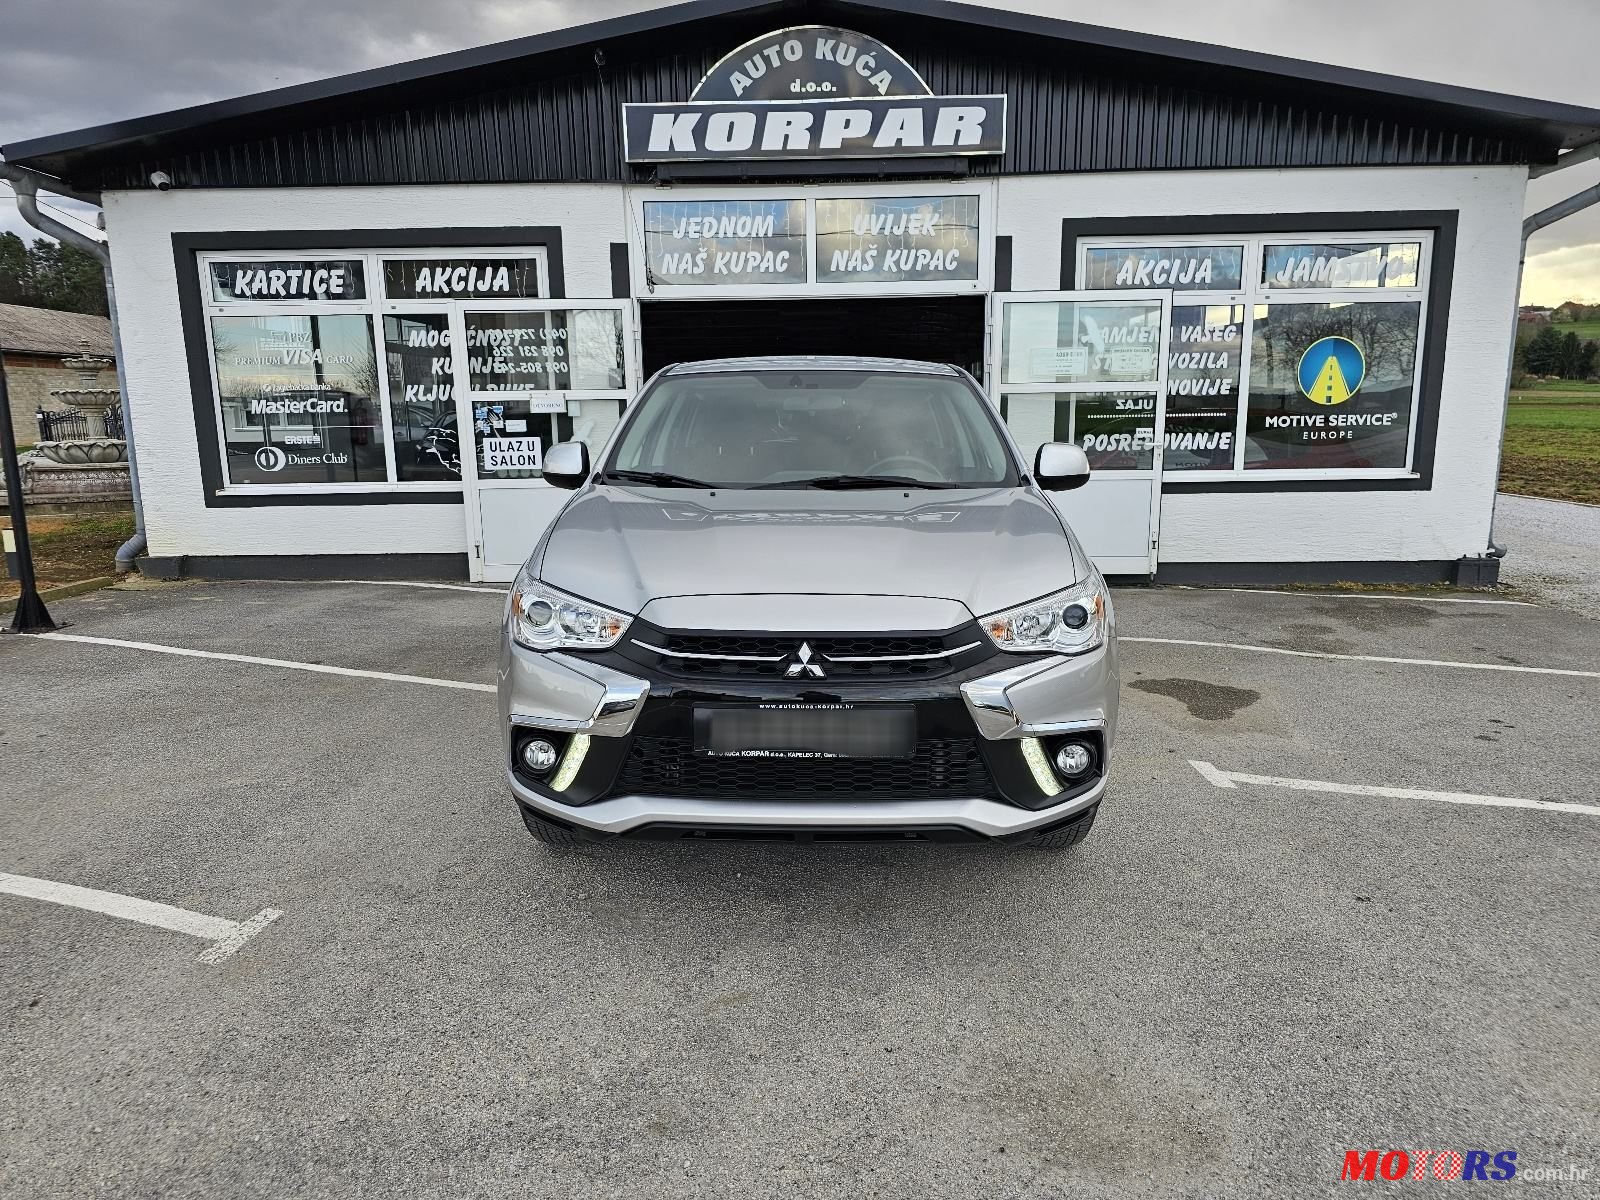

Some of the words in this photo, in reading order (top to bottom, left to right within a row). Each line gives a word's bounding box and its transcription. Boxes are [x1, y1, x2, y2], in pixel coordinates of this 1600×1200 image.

[729, 38, 803, 97] AUTO
[815, 37, 893, 96] KUĆA
[790, 79, 836, 93] d.o.o.
[647, 106, 987, 152] KORPAR
[672, 214, 774, 240] JEDNOM
[853, 212, 940, 238] UVIJEK
[661, 247, 708, 275] NAŠ
[714, 250, 789, 274] KUPAC
[829, 244, 877, 273] NAŠ
[883, 247, 960, 273] KUPAC
[415, 266, 510, 294] AKCIJA
[1115, 258, 1212, 287] AKCIJA
[234, 269, 345, 297] KARTICE
[282, 348, 323, 365] VISA
[326, 356, 354, 364] CARD
[1169, 352, 1229, 369] VOZILA
[431, 357, 504, 375] KUNJE
[1168, 378, 1233, 396] NOVIJE
[1265, 414, 1325, 428] MOTIVE
[284, 435, 312, 445] ERSTE
[1302, 431, 1353, 440] EUROPE
[489, 440, 522, 452] ULAZ
[527, 440, 535, 452] U
[288, 453, 321, 464] Diners
[491, 454, 536, 466] SALON
